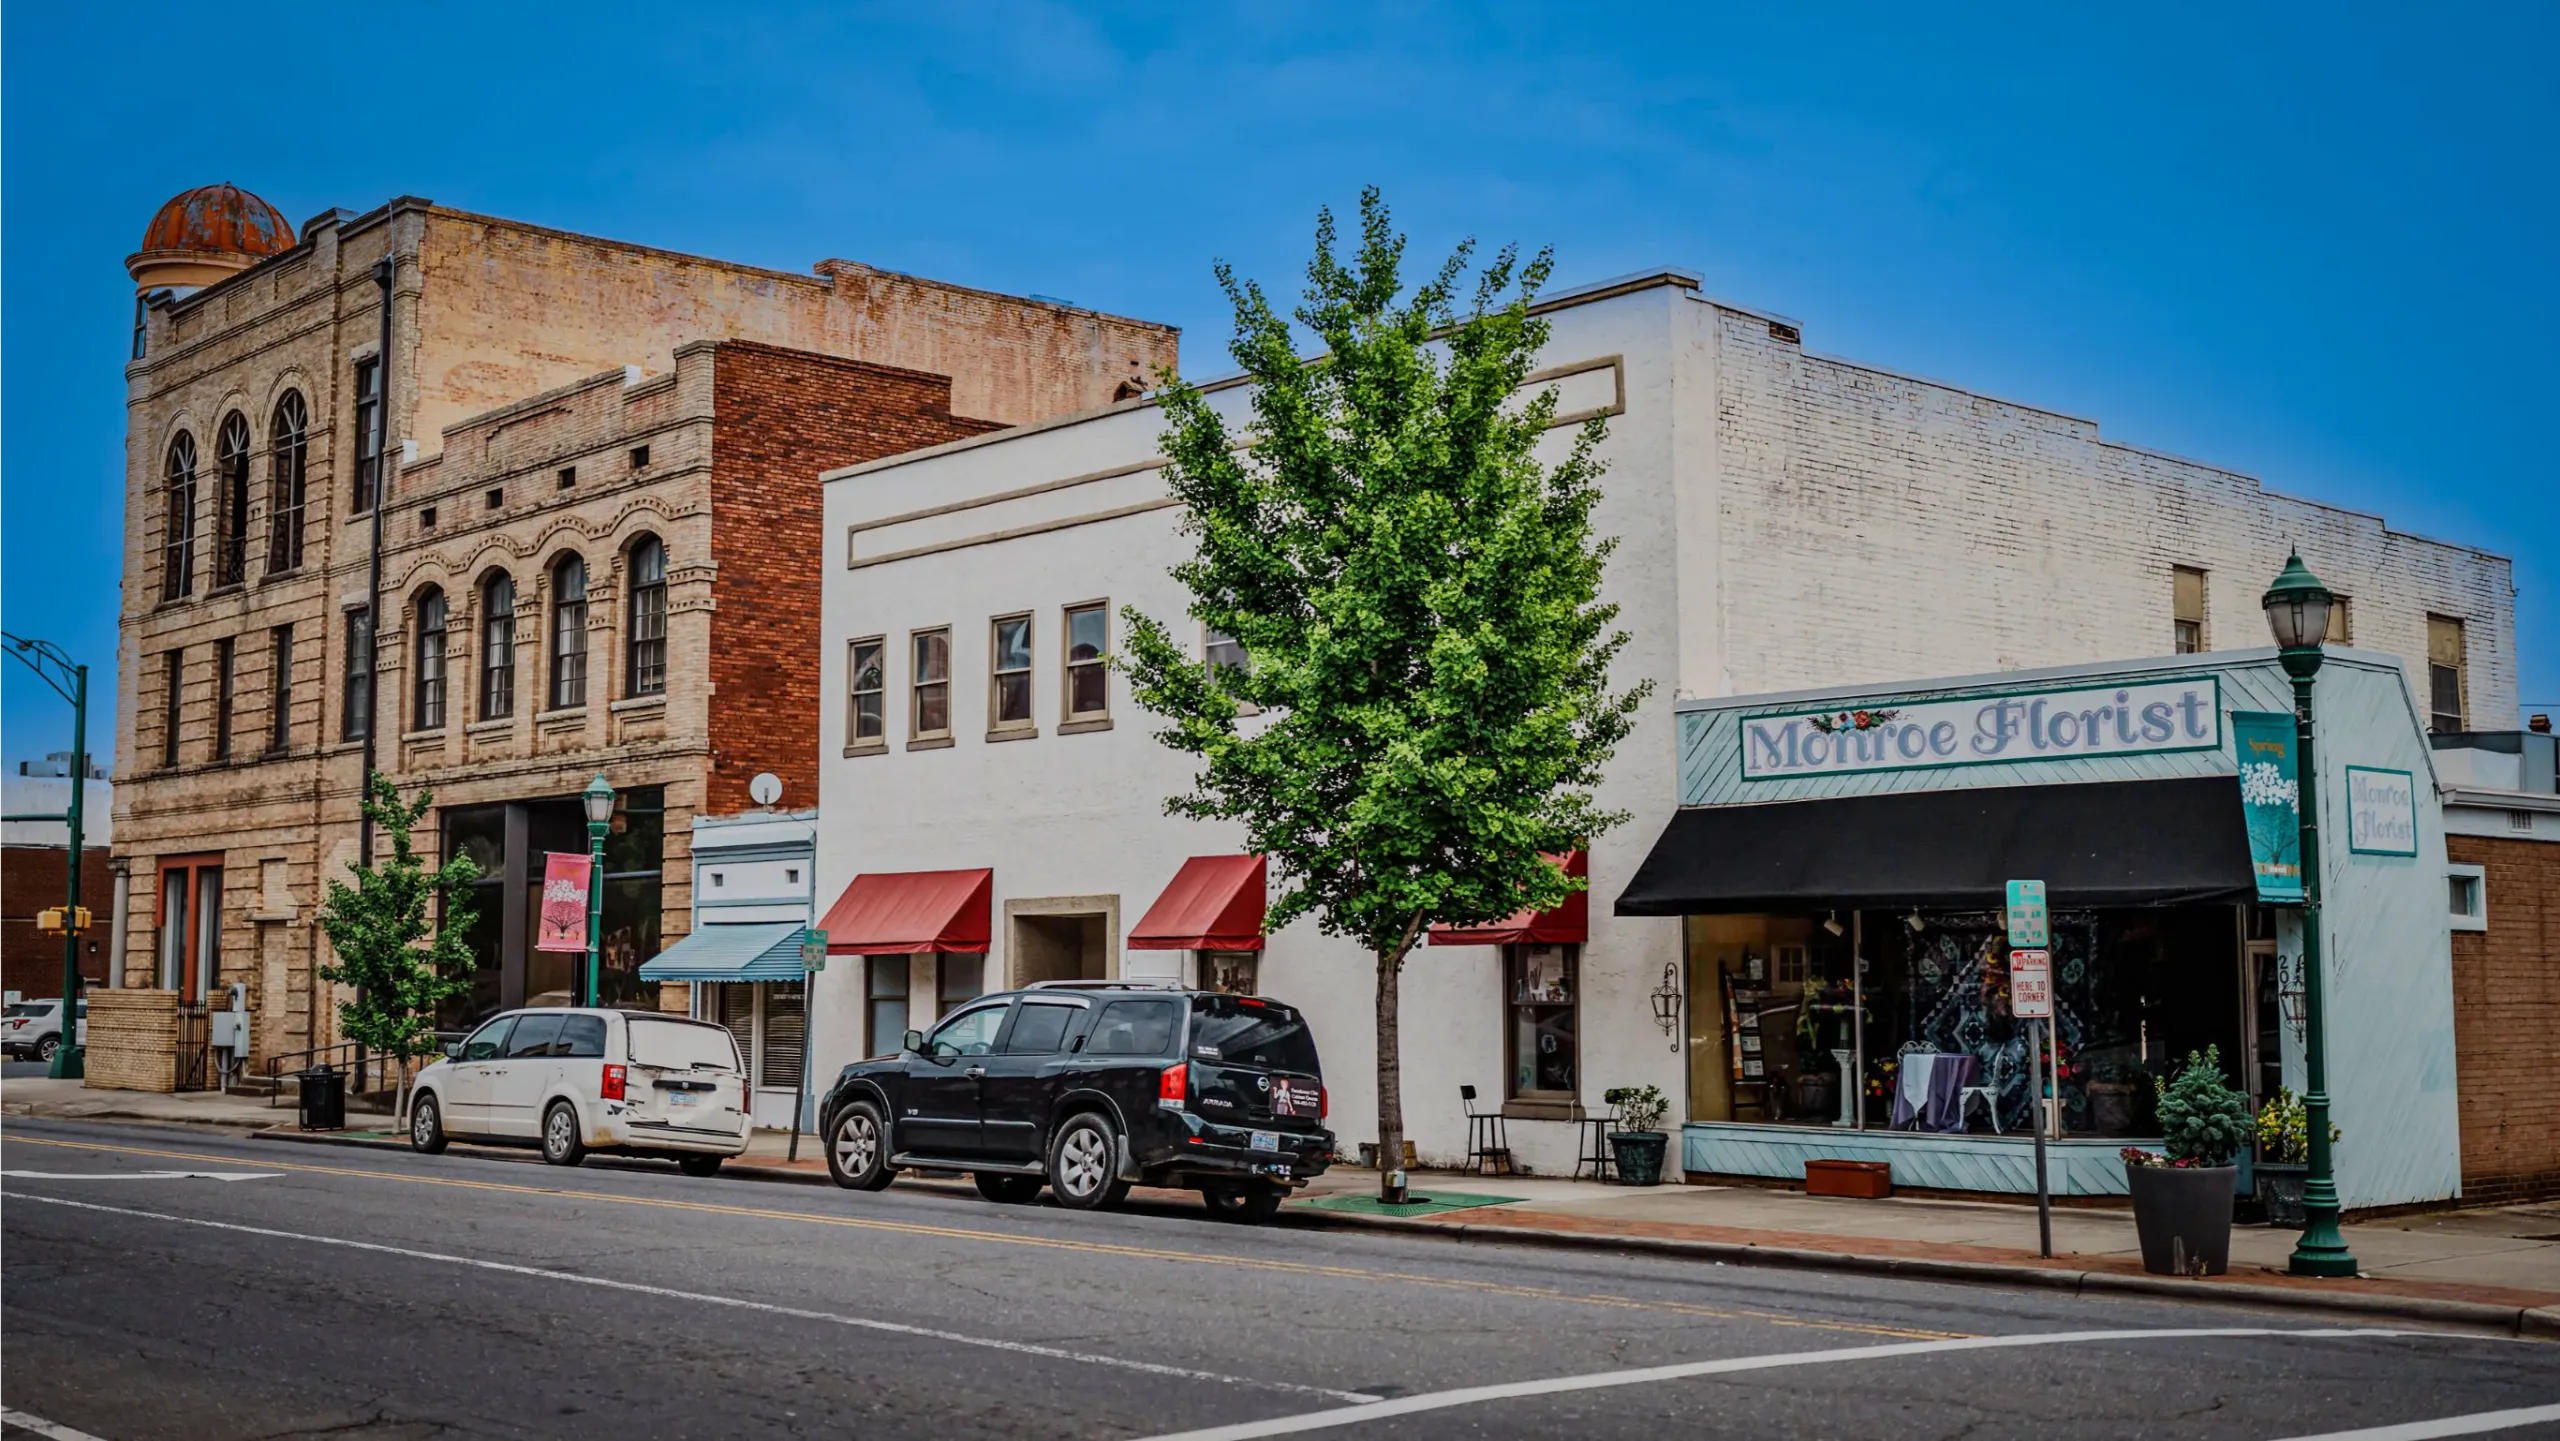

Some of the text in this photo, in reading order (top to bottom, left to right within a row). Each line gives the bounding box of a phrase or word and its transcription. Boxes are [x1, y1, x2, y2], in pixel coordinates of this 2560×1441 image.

[1747, 689, 2209, 771] Monroe Florist
[2248, 737, 2286, 758] Spring
[2351, 775, 2410, 807] Monroe
[2354, 808, 2413, 847] Florist
[2012, 955, 2046, 968] NO PARKING
[2016, 980, 2046, 991] HERE TO
[2018, 992, 2046, 1003] CORNER
[1203, 1098, 1233, 1108] ARMADA
